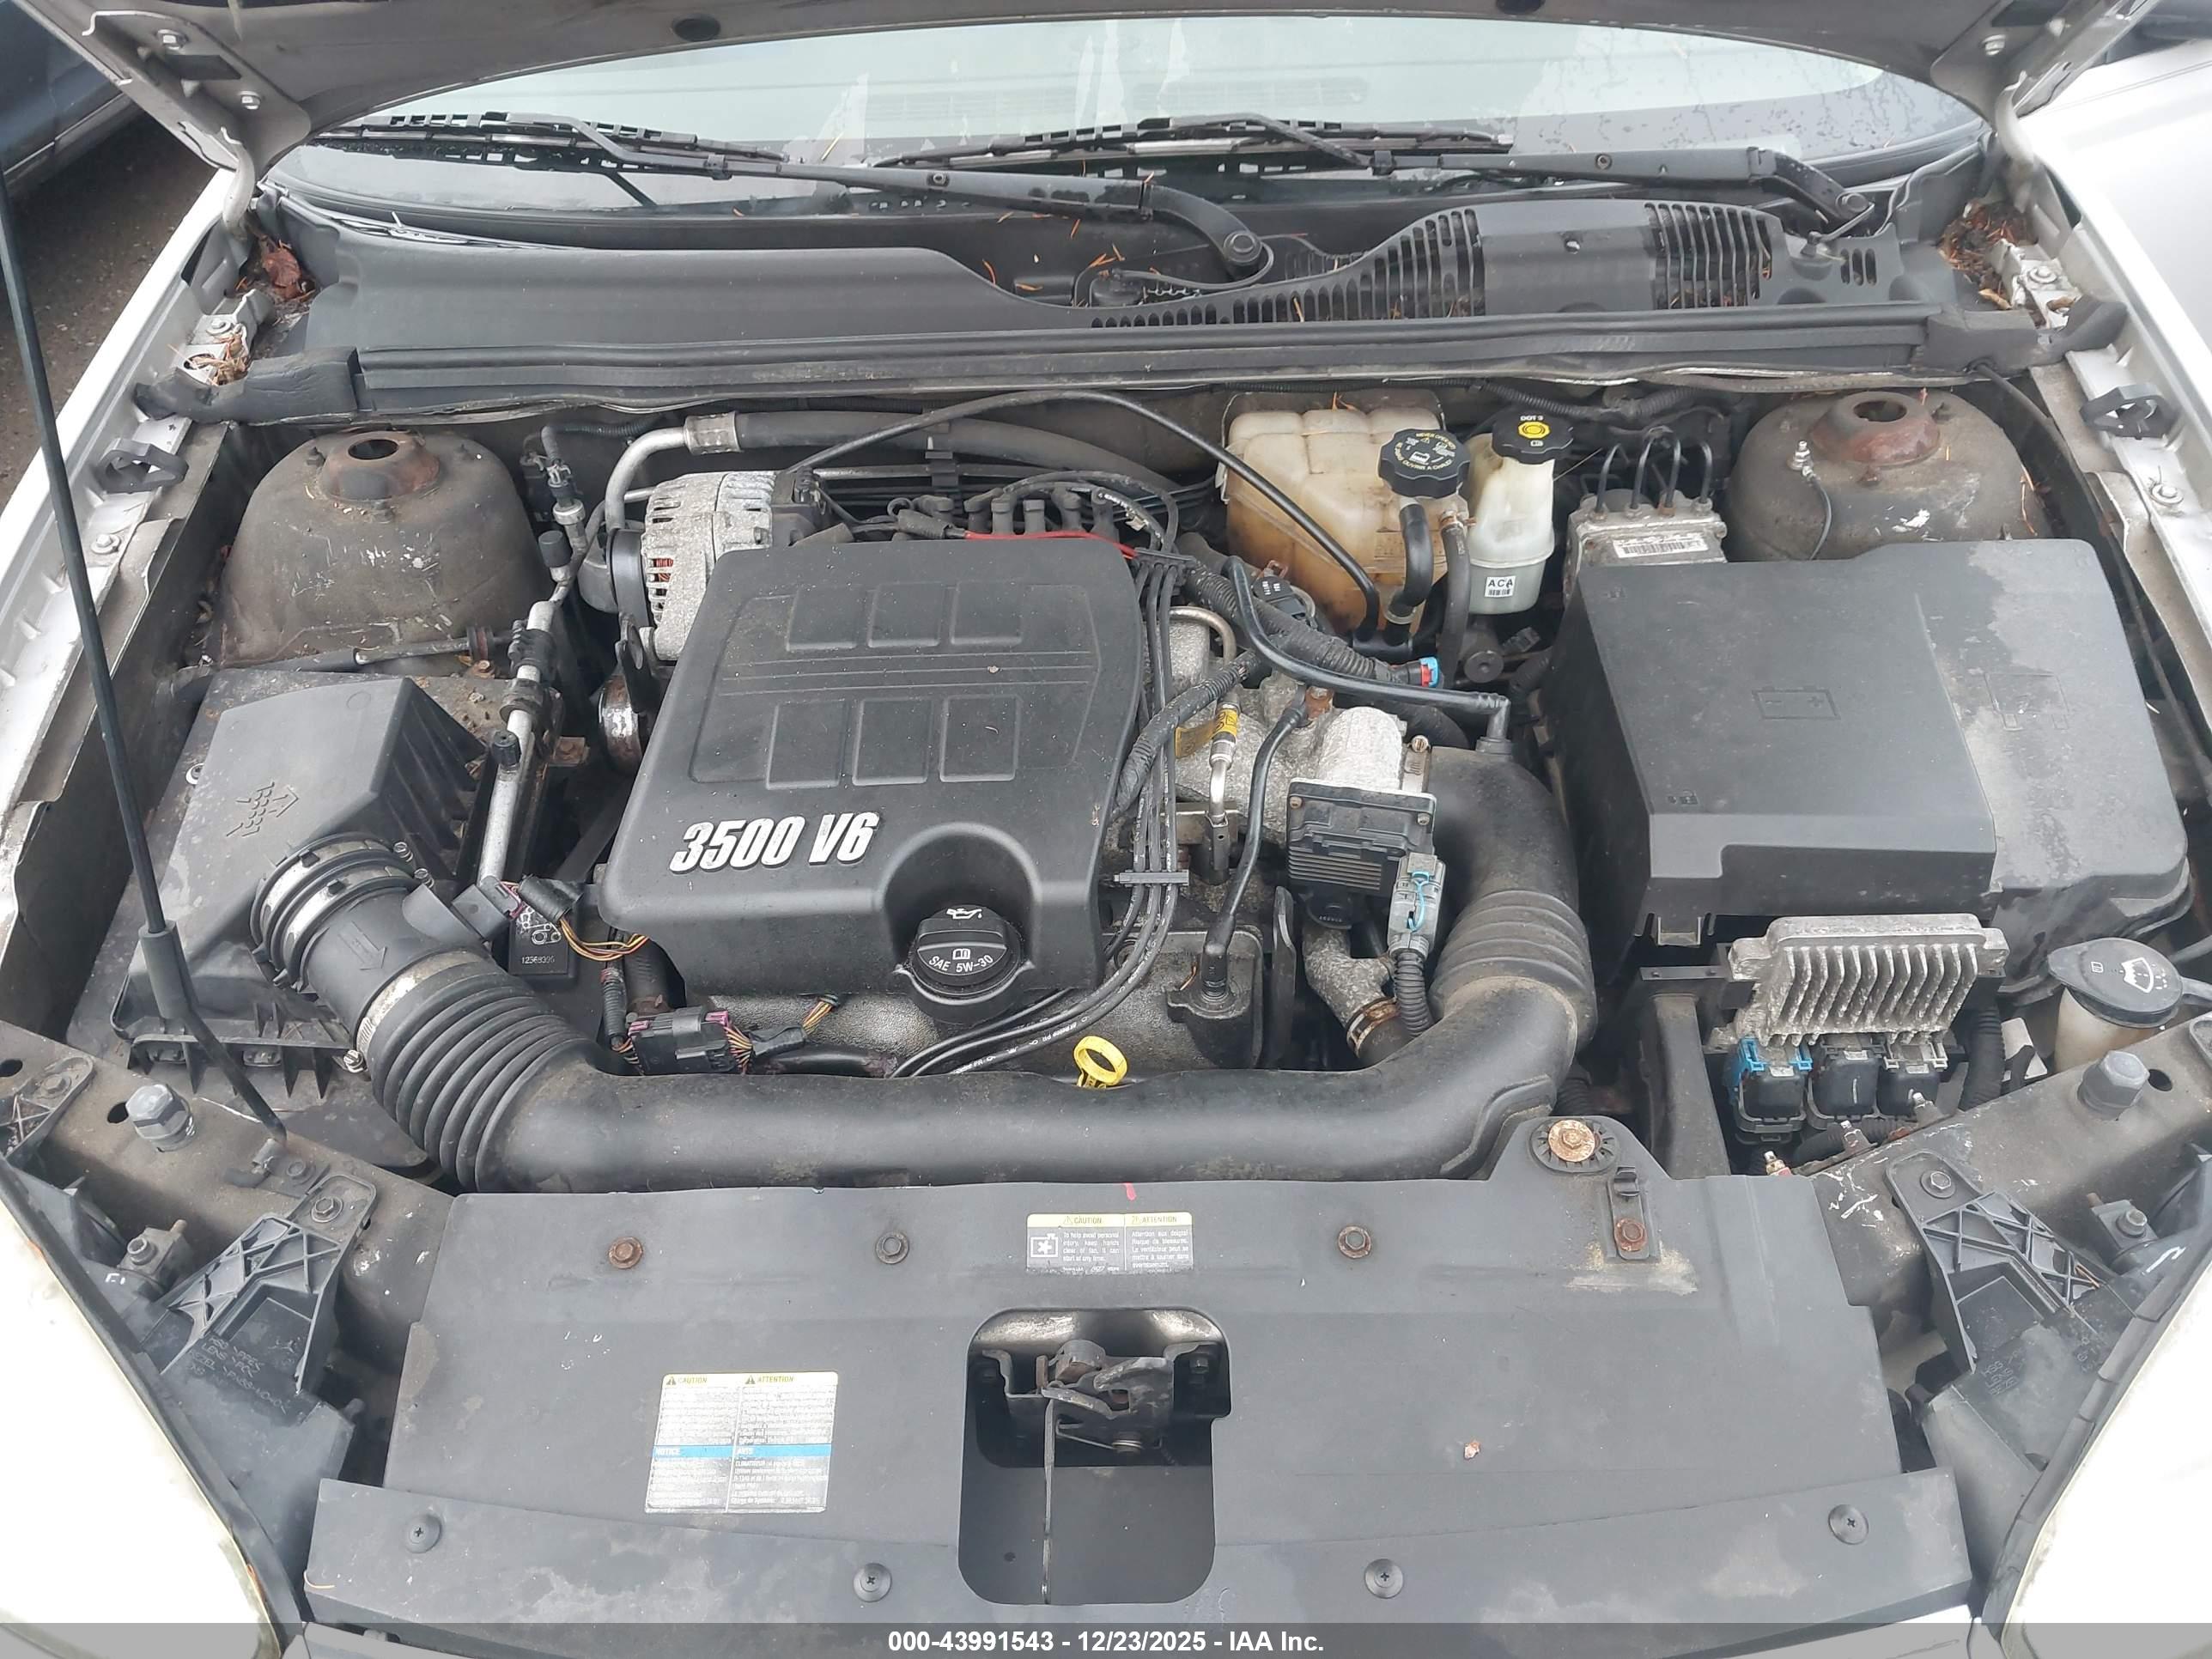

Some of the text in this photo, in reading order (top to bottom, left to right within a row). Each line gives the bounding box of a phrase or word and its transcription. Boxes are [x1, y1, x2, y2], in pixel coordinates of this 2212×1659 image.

[1487, 579, 1514, 588] ACA
[670, 811, 881, 874] 3500 V6
[928, 954, 994, 973] SAE 5W-30
[1073, 1216, 1103, 1224] CAUTION
[1142, 1215, 1178, 1224] ATTENTION
